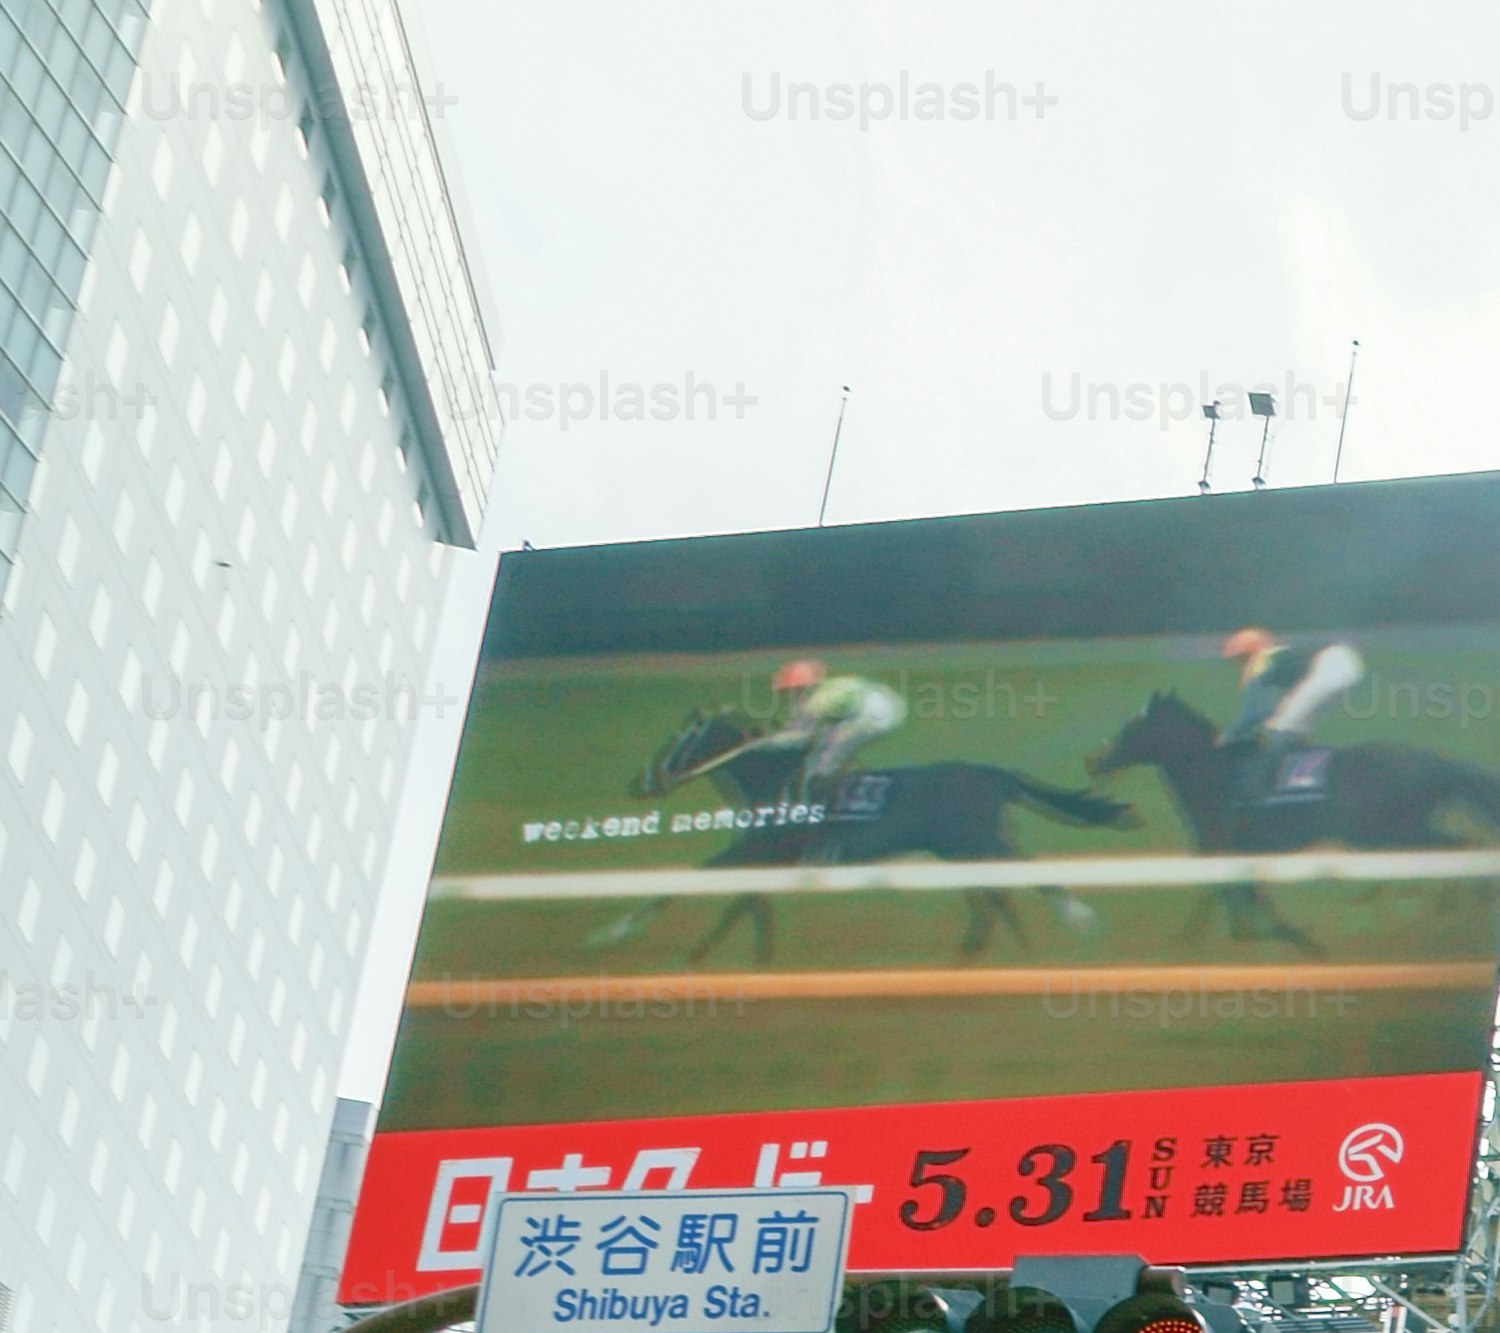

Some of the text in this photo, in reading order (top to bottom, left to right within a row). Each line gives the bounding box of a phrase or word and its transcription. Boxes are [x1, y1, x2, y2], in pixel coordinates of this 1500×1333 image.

[522, 799, 826, 845] weekend memories
[1200, 1132, 1280, 1169] 東京
[899, 1139, 1132, 1231] 5.31
[1190, 1177, 1314, 1218] 競馬場
[1332, 1184, 1396, 1212] JRA
[514, 1209, 821, 1279] 渋谷駅前
[553, 1284, 772, 1327] Shibuya Sta.
